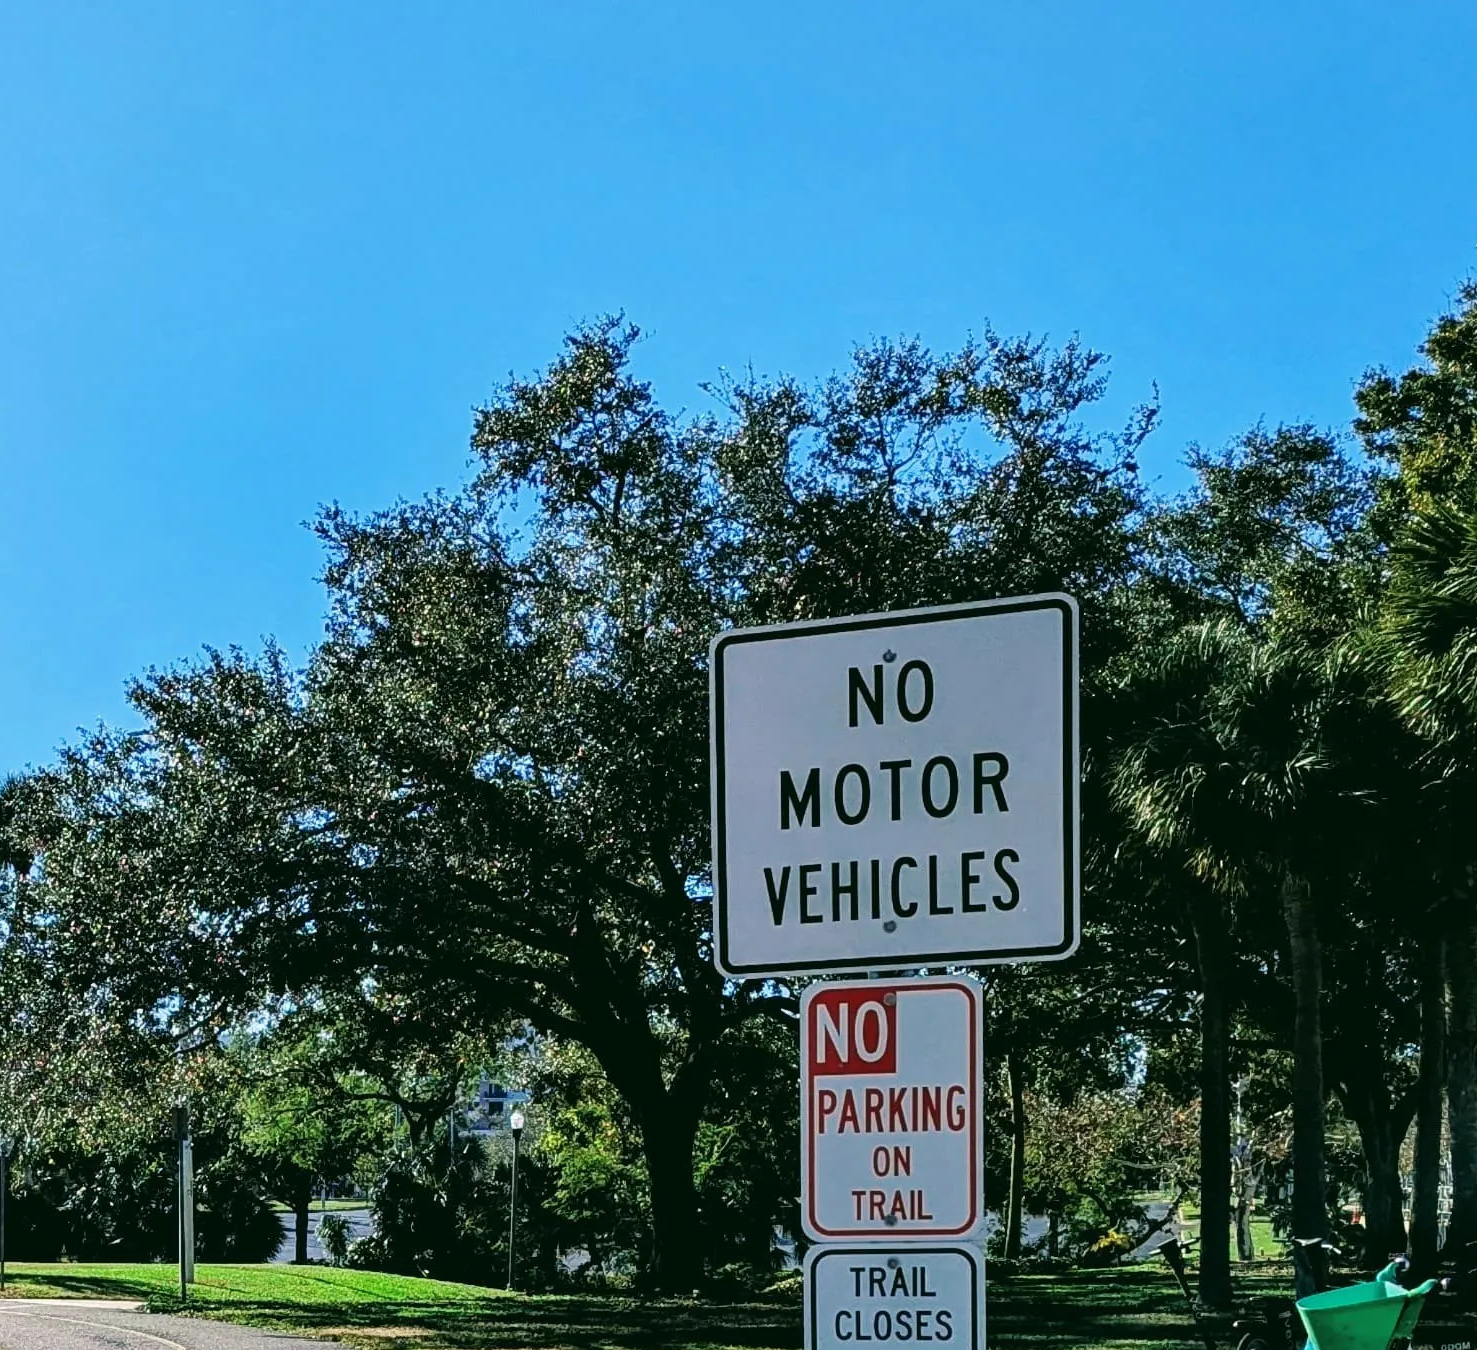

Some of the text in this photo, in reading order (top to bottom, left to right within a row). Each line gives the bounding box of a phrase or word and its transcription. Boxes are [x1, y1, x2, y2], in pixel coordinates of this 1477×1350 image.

[848, 660, 934, 727] NO
[780, 752, 1009, 830] MOTOR
[763, 848, 1020, 926] VEHICLES
[816, 1001, 888, 1064] NO
[818, 1085, 966, 1134] PARKING
[873, 1146, 911, 1177] ON
[851, 1190, 933, 1221] TRAIL
[849, 1266, 937, 1298] TRAIL
[835, 1310, 953, 1341] CLOSES
